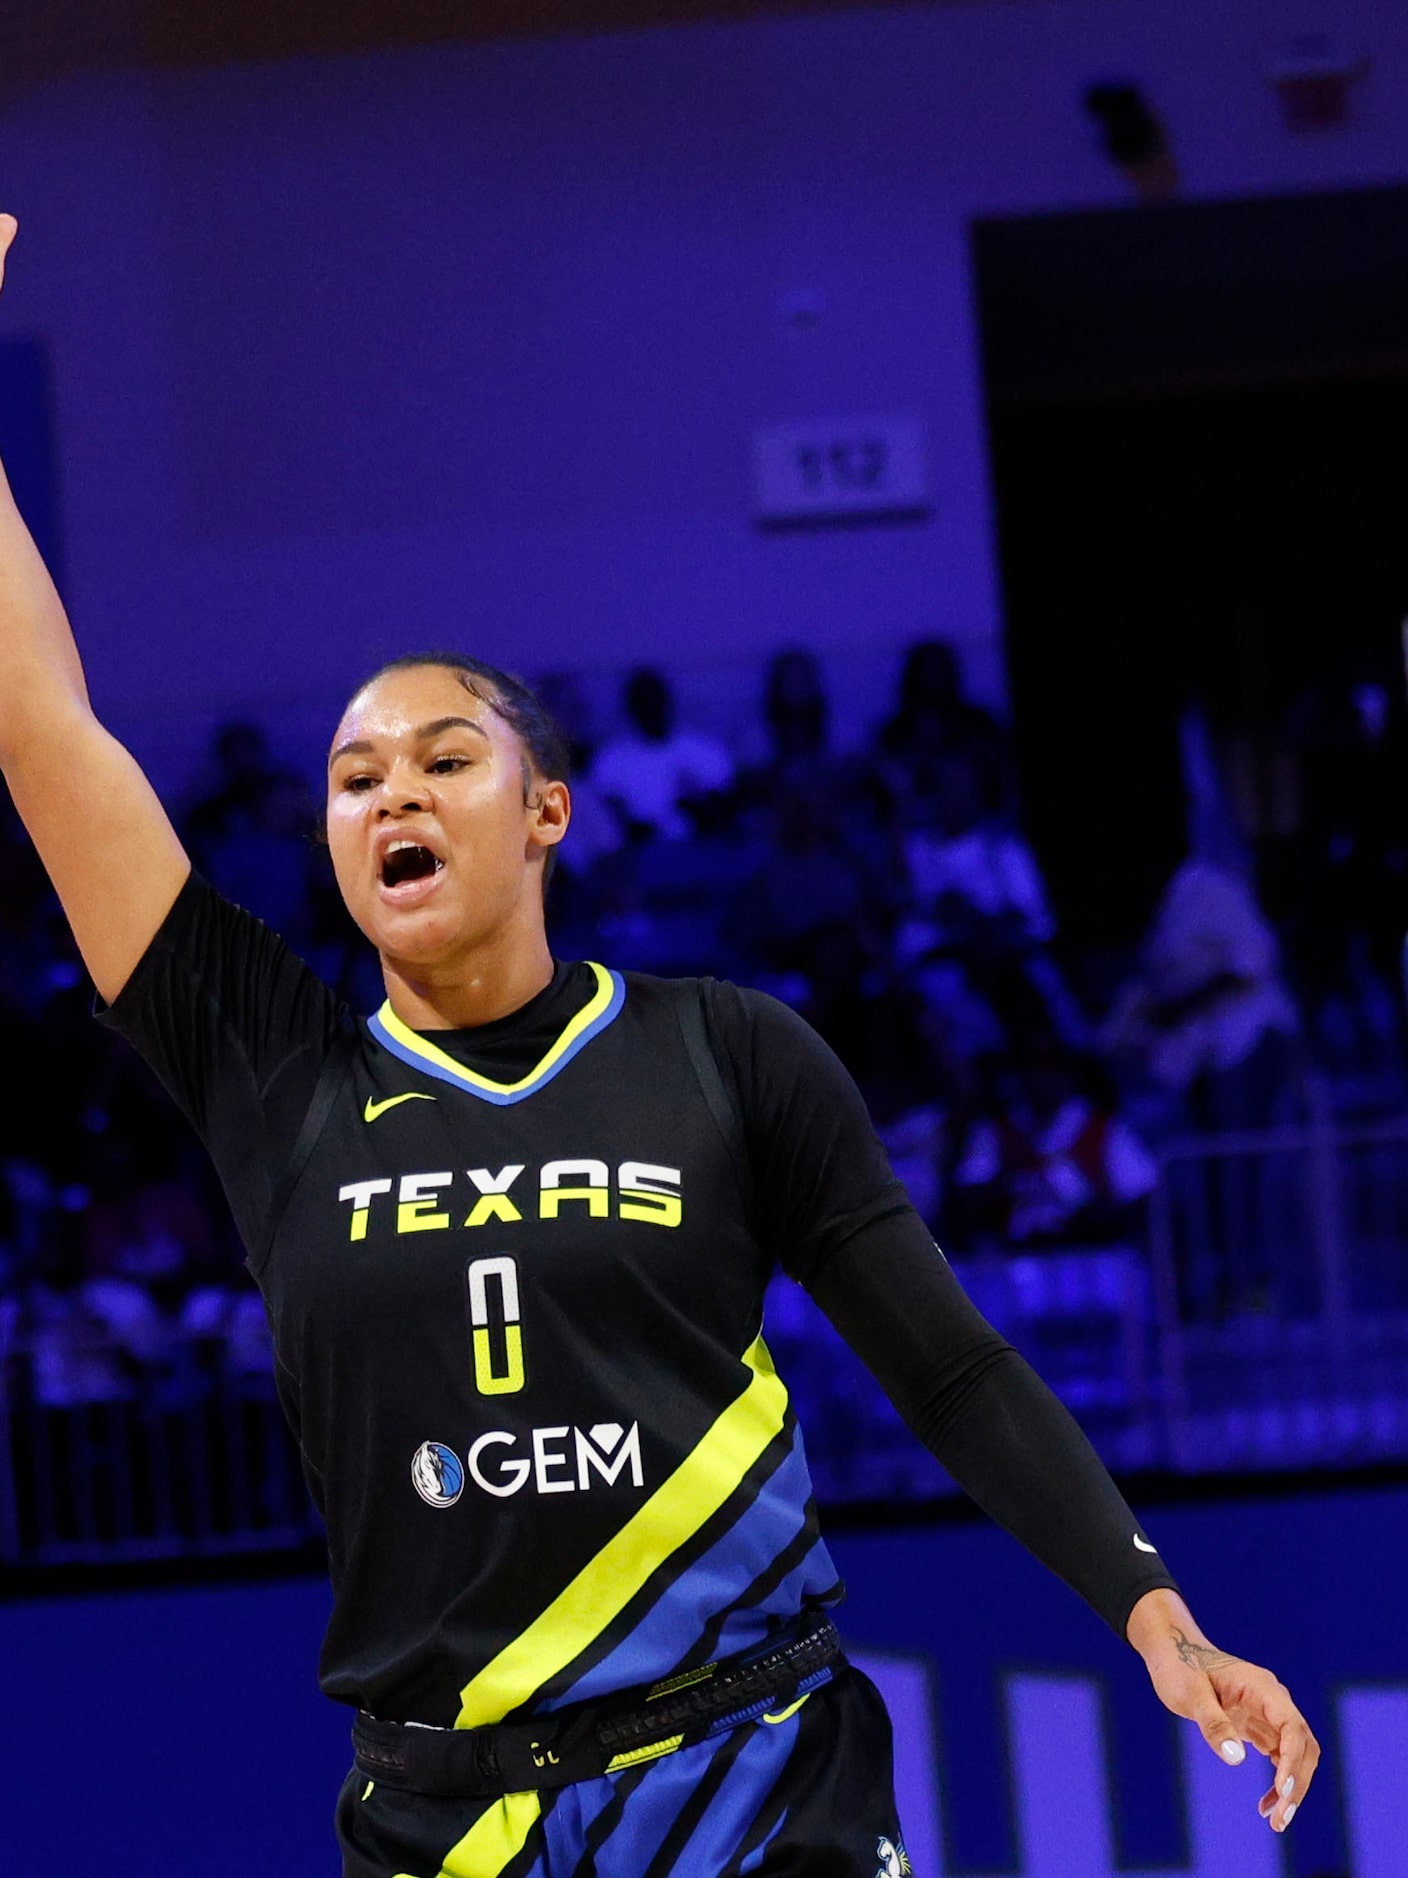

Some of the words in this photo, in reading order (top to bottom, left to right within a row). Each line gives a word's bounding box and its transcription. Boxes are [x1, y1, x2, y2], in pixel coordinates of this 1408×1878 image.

[338, 1158, 683, 1242] TEXAS
[468, 1256, 525, 1396] 0
[469, 1421, 644, 1498] GEM
